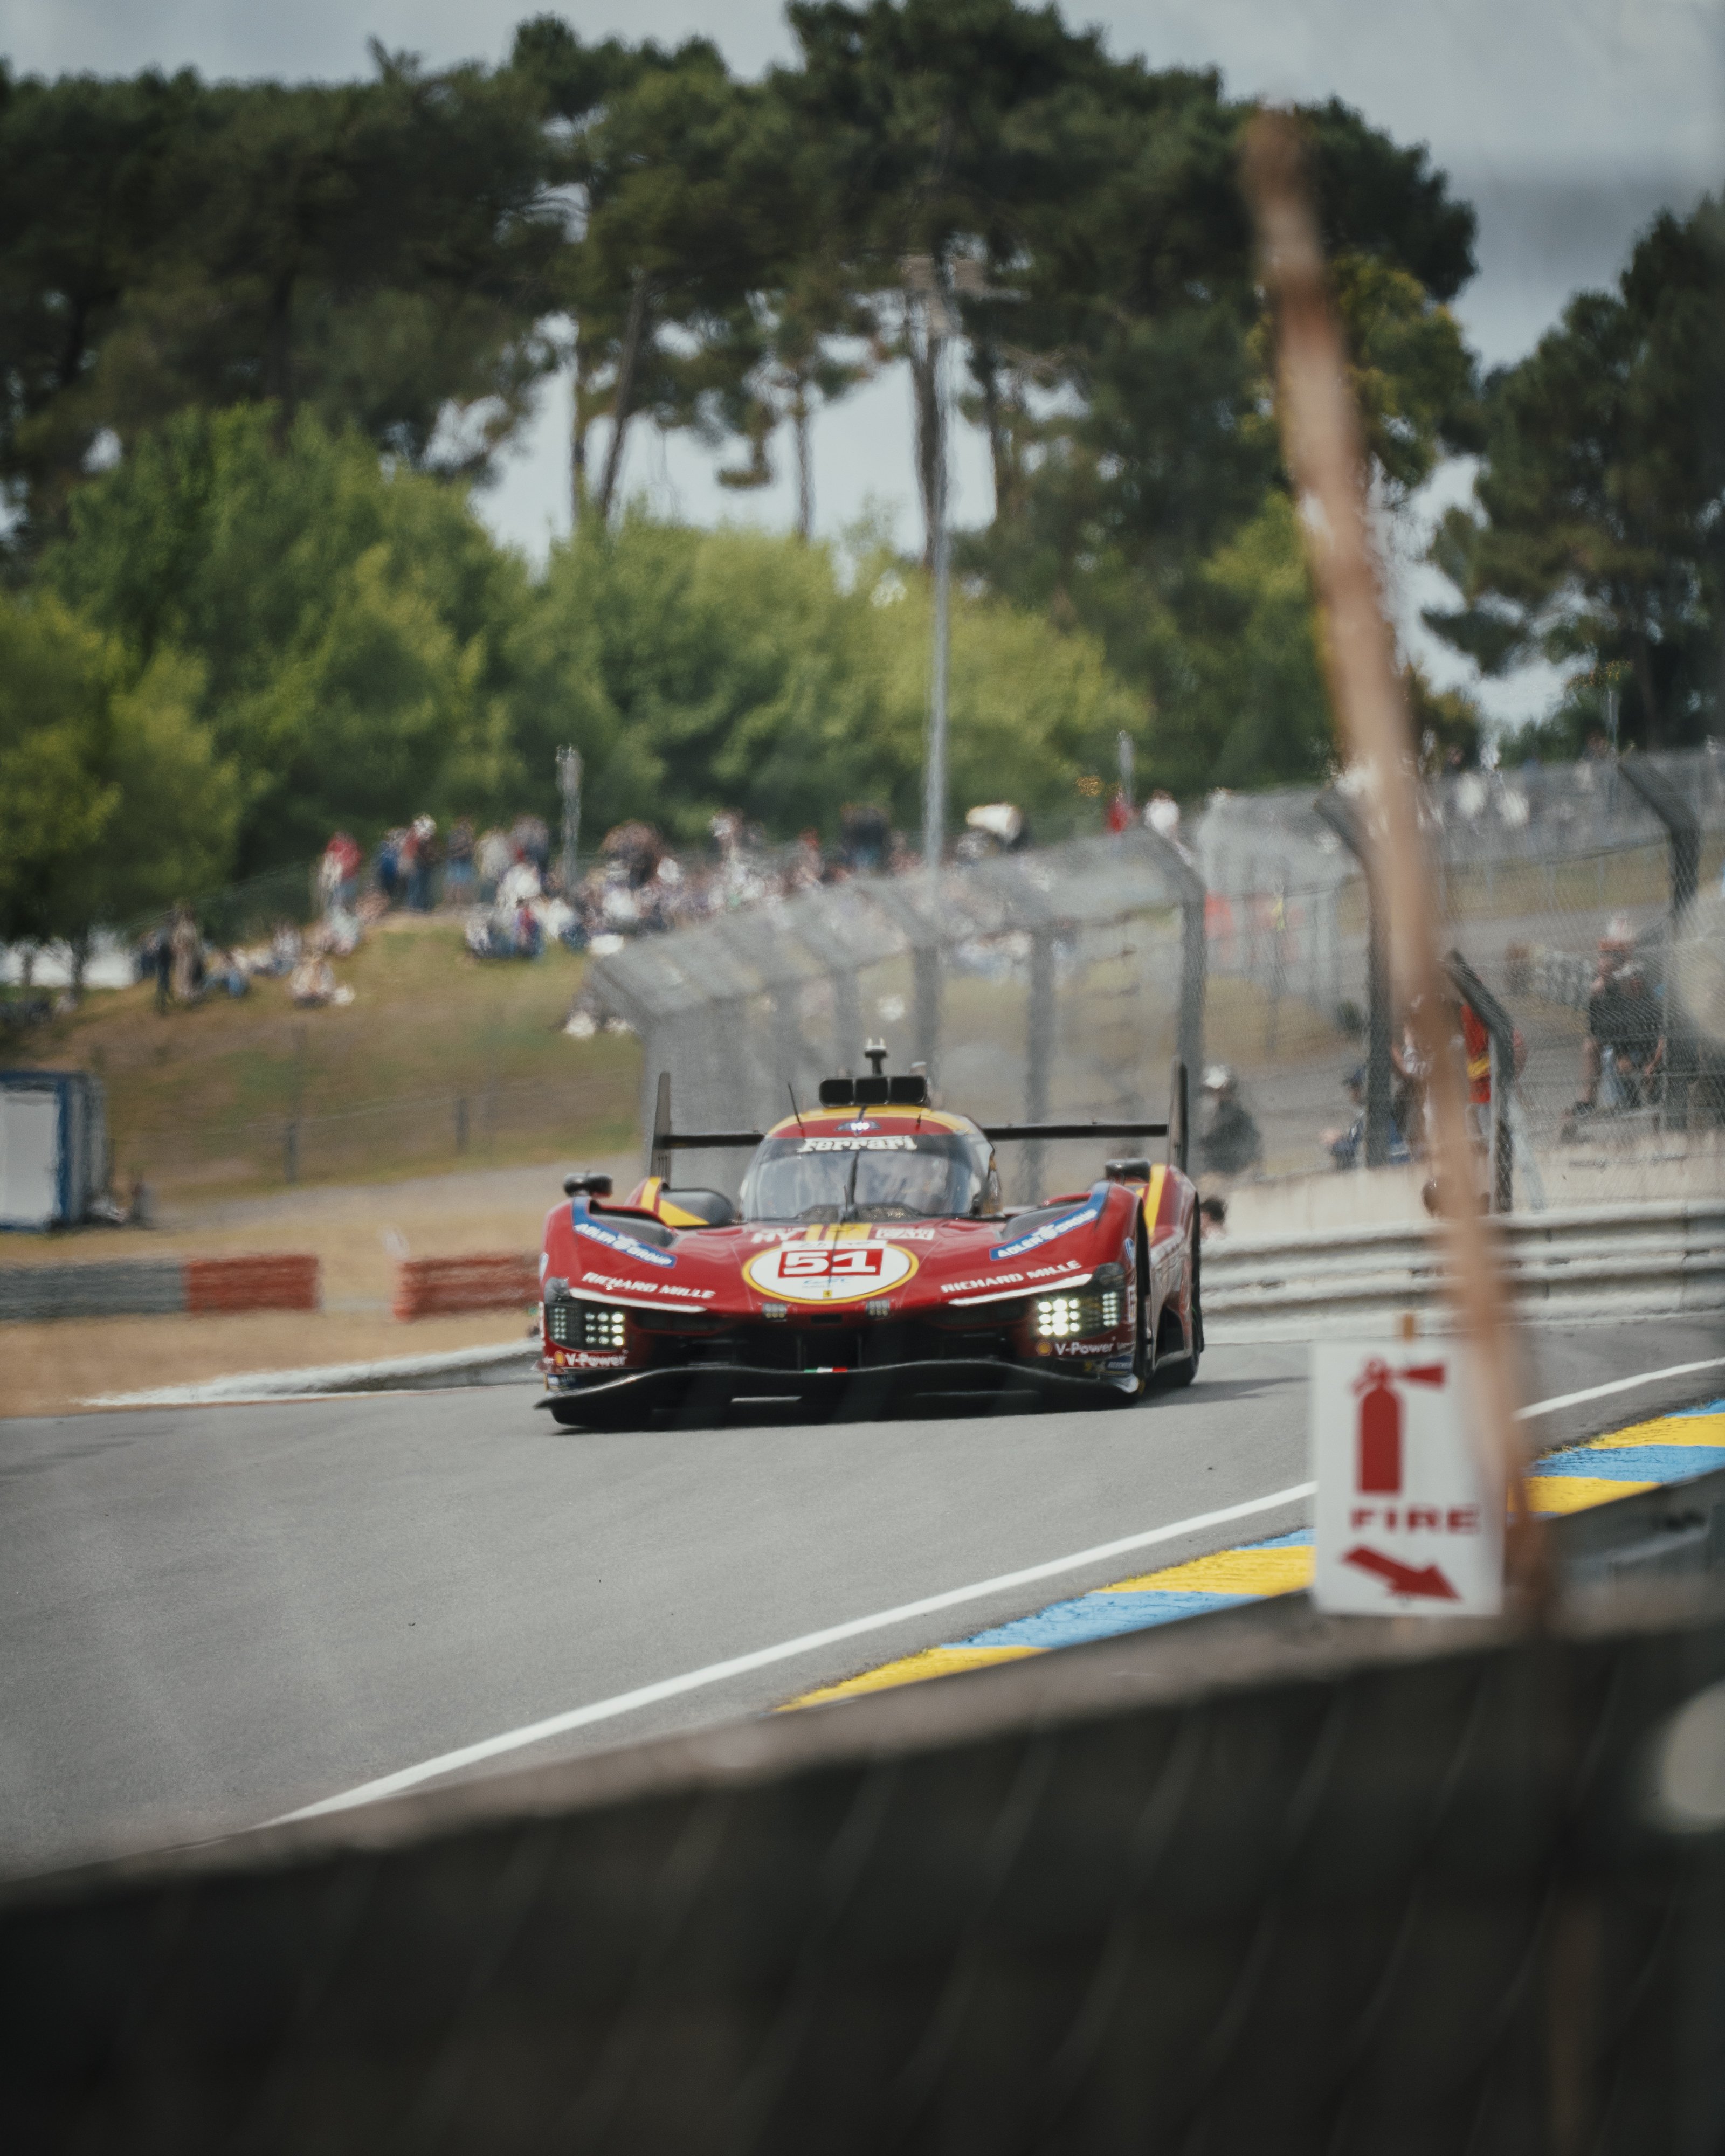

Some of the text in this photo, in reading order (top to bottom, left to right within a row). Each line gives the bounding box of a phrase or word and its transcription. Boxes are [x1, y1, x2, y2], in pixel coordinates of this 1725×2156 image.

[796, 1135, 917, 1153] Ferrari
[574, 1223, 617, 1244] ADLER
[998, 1235, 1044, 1257] ADLER
[783, 1250, 877, 1275] 51
[581, 1272, 716, 1299] RICHARD MILLE
[941, 1260, 1083, 1293] RICHARD MILLE
[564, 1353, 627, 1366] V-Power
[1055, 1341, 1114, 1356] V-Power
[1350, 1506, 1480, 1535] FIRE
